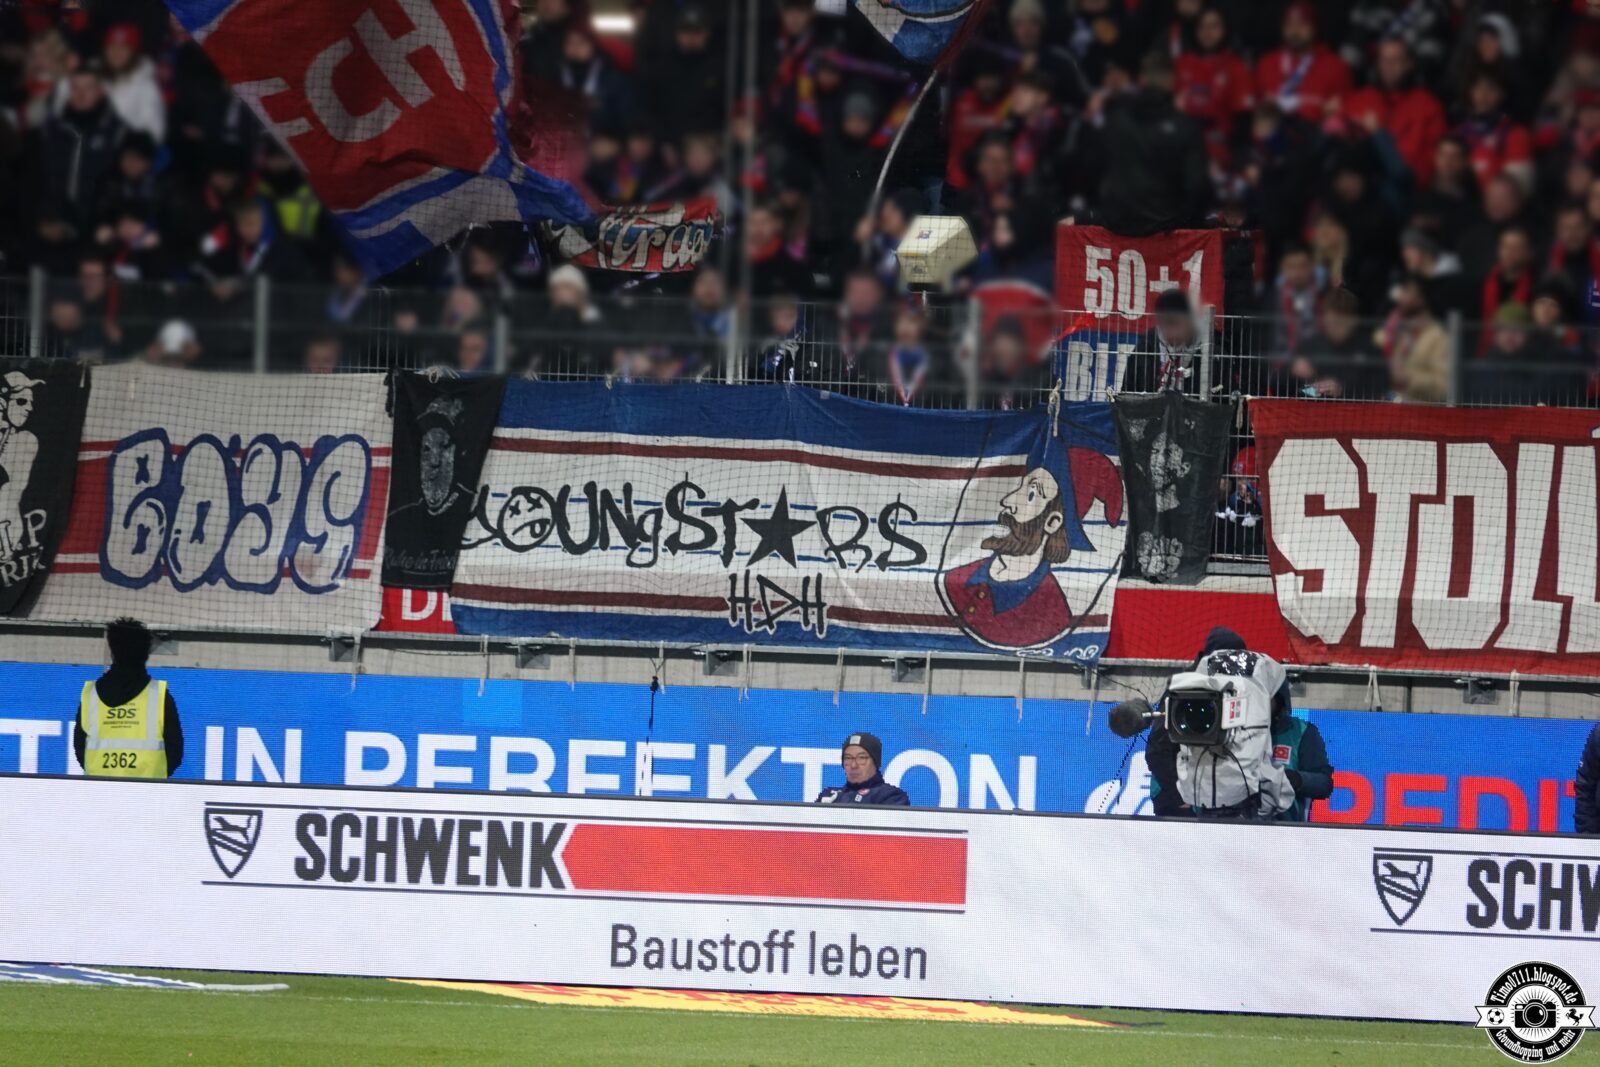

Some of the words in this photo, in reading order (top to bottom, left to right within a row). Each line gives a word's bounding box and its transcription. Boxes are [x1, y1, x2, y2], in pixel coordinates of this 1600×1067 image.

[232, 0, 466, 150] FCH
[1084, 245, 1204, 320] 50+1
[106, 708, 137, 719] SDS
[102, 752, 137, 769] 2362
[204, 726, 302, 783] IN
[344, 731, 1037, 812] PERFEKTON
[295, 812, 568, 890] SCHWENK
[611, 924, 795, 974] Baustoff
[809, 930, 927, 980] leben
